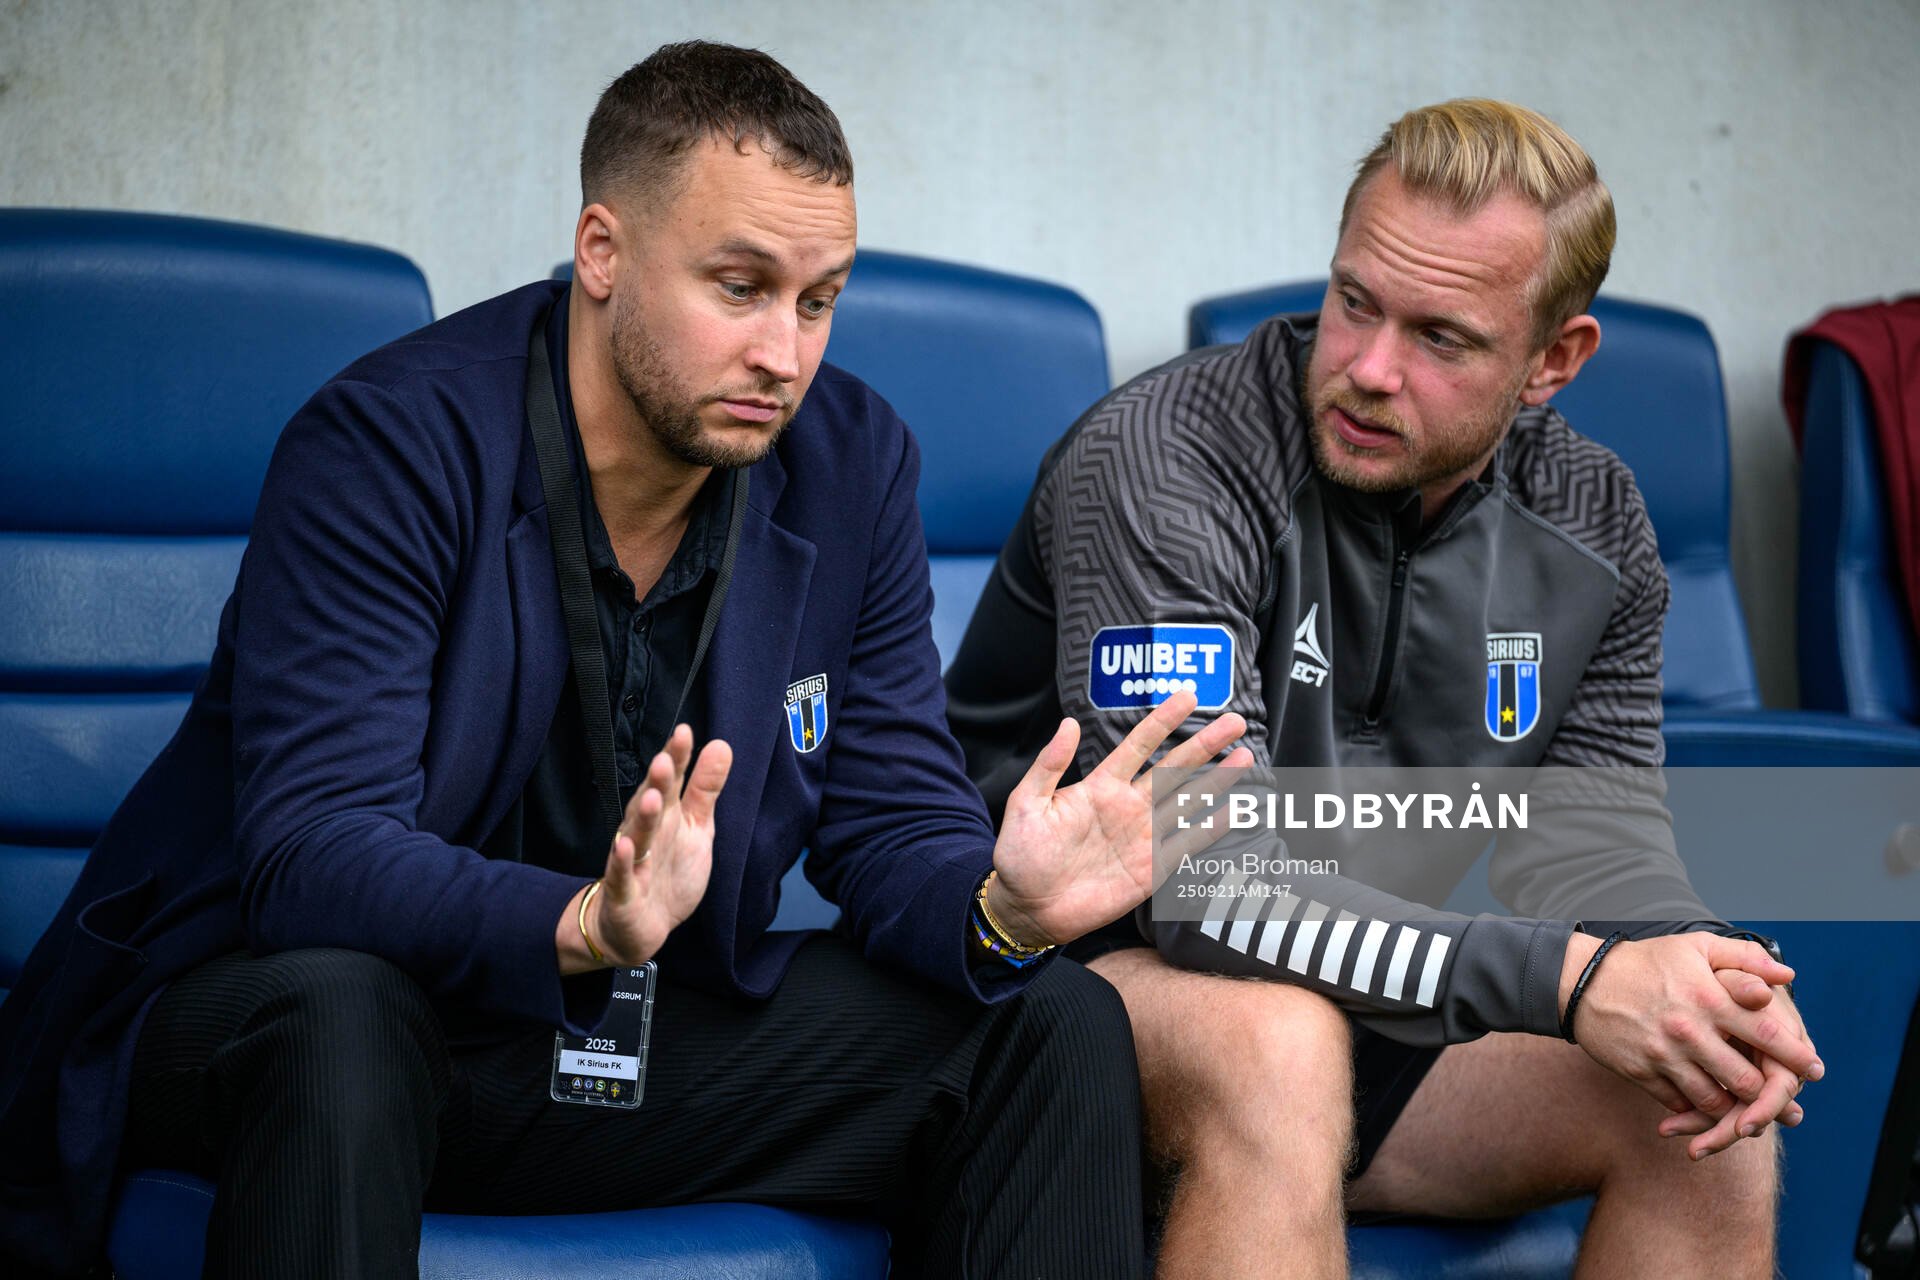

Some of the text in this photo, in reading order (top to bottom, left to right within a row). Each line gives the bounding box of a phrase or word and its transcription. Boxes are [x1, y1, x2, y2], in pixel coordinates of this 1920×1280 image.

[1101, 643, 1222, 675] UNIBET
[1487, 639, 1535, 660] SIRIUS
[1291, 660, 1329, 688] ECT
[786, 678, 823, 703] SIRIUS
[630, 969, 645, 978] 018
[585, 1037, 616, 1052] 2025
[577, 1058, 622, 1070] IK Sirius FK
